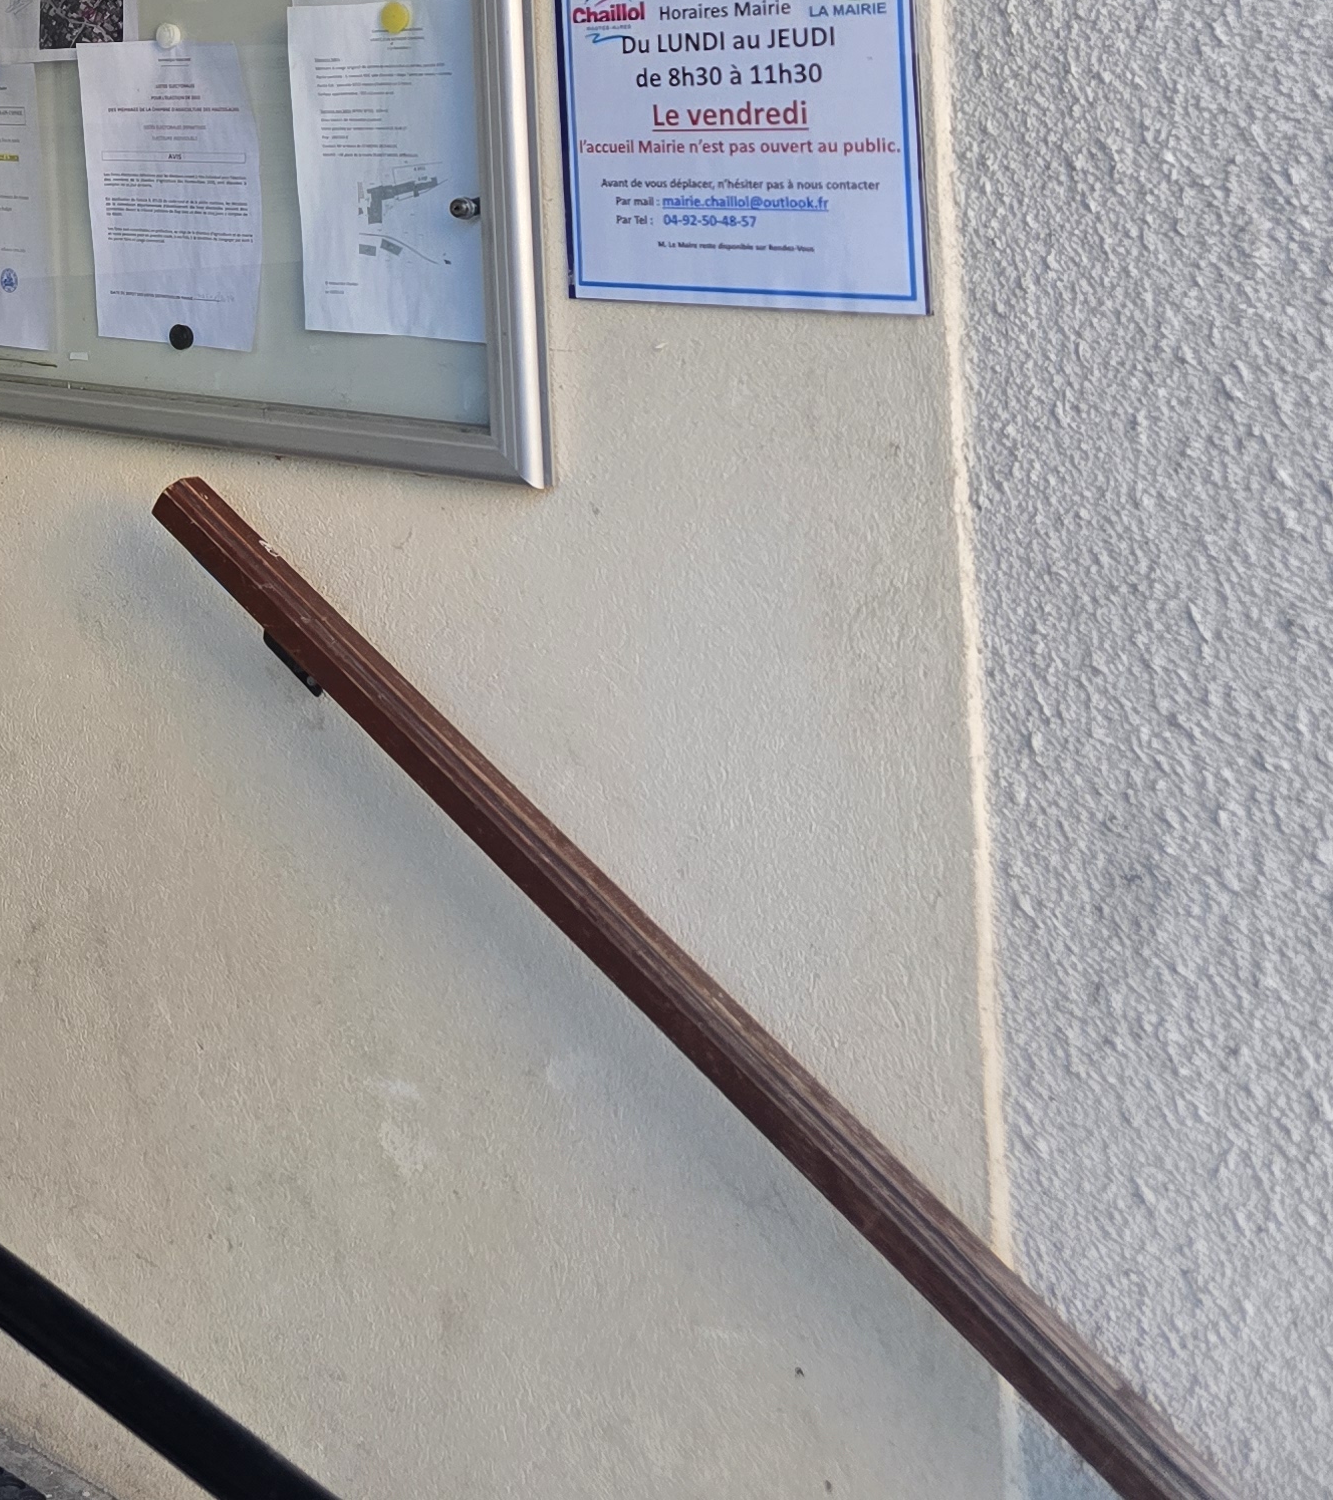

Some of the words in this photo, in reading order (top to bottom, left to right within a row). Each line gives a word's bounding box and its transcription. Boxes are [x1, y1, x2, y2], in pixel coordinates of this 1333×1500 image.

[573, 2, 645, 24] Chaillol
[659, 5, 728, 21] Horaires
[734, 1, 791, 17] Mairie
[809, 5, 829, 18] LA
[833, 3, 887, 16] MAIRIE
[622, 35, 650, 54] Du
[657, 31, 724, 53] LUNDI
[733, 34, 760, 49] au
[767, 26, 835, 50] JEUDI
[636, 69, 661, 88] de
[668, 66, 722, 87] 8h30
[729, 64, 742, 85] à
[750, 63, 822, 84] 11h30
[653, 103, 679, 127] Le
[687, 100, 808, 126] vendredi
[579, 140, 634, 154] l'accueil
[639, 140, 685, 154] Mairie
[690, 141, 724, 154] n'est
[729, 143, 756, 155] pas
[761, 141, 812, 153] ouvert
[818, 142, 838, 153] au
[843, 139, 901, 155] public.
[601, 179, 628, 188] Avant
[631, 179, 642, 188] de
[670, 179, 713, 191] déplacer,
[717, 180, 762, 189] n'hésiter
[766, 182, 785, 191] pas
[788, 180, 793, 190] à
[826, 182, 880, 190] contacter
[616, 197, 634, 206] Par
[636, 197, 656, 206] mail
[662, 195, 829, 211] mairie.chaillol@outlook.fr
[616, 215, 633, 224] Par
[635, 215, 650, 224] Tel
[663, 215, 756, 227] 04-92-50-48-57
